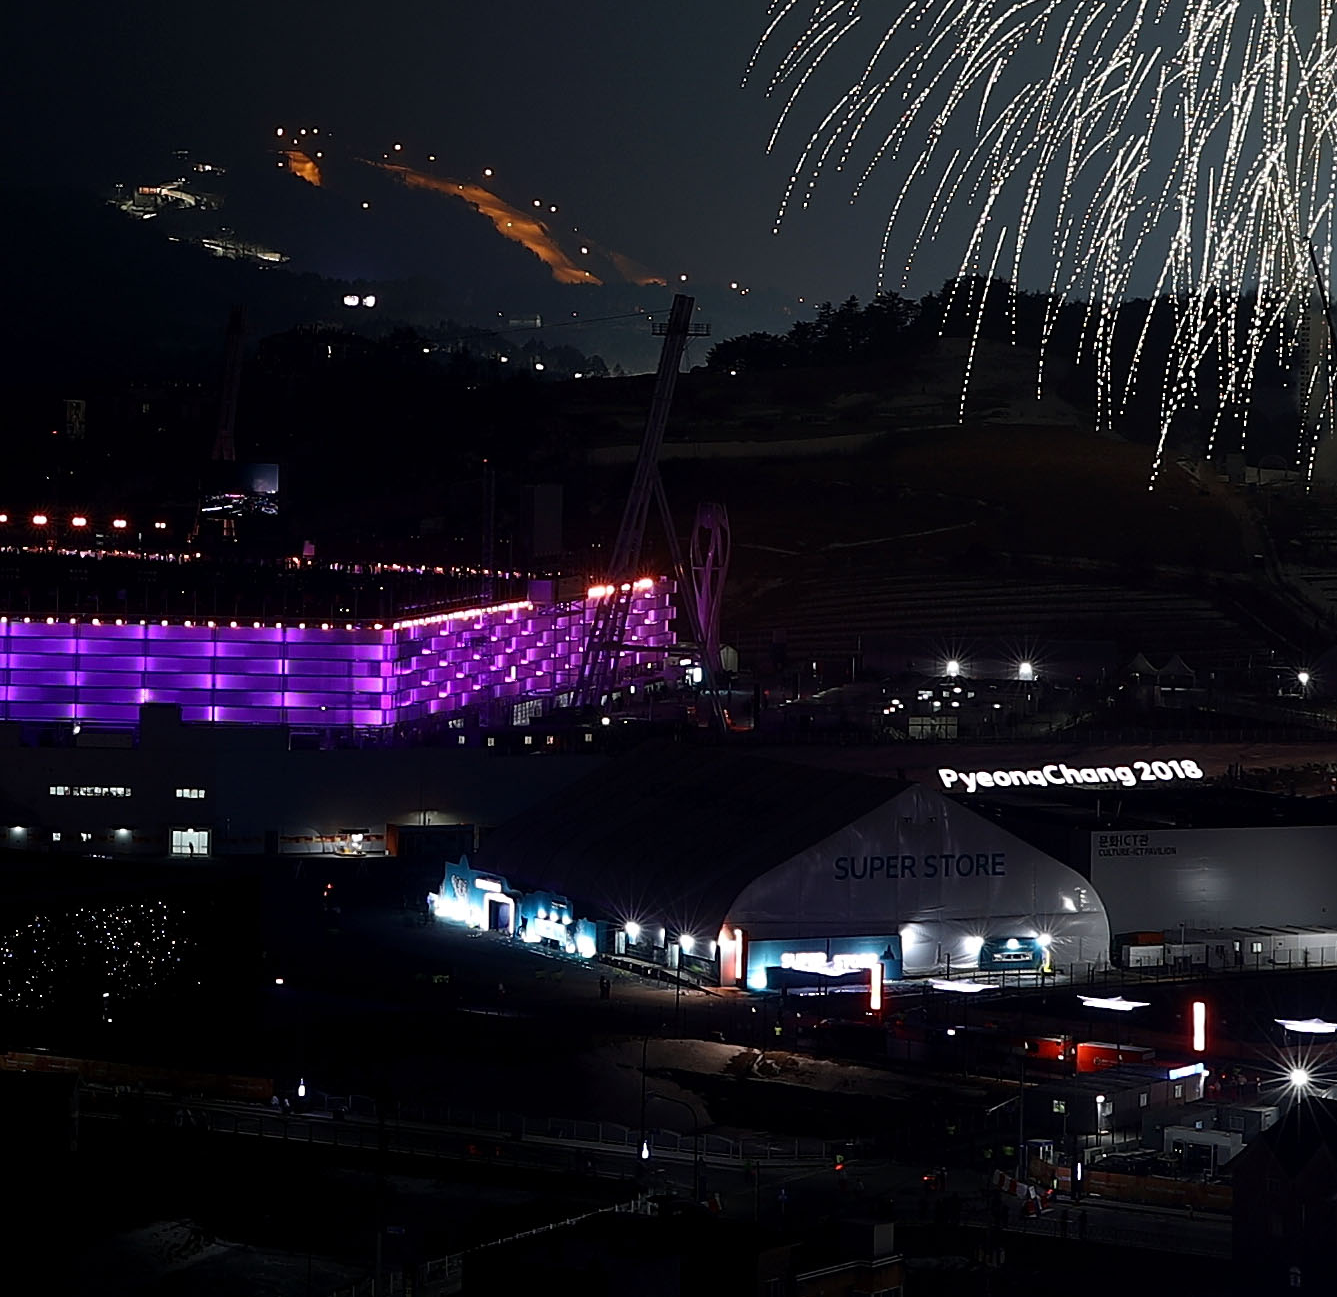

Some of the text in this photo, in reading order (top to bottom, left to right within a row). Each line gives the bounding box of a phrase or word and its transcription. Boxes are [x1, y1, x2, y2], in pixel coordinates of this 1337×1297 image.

[938, 760, 1203, 793] PyeongChang 2018
[834, 853, 1006, 880] SUPER STORE
